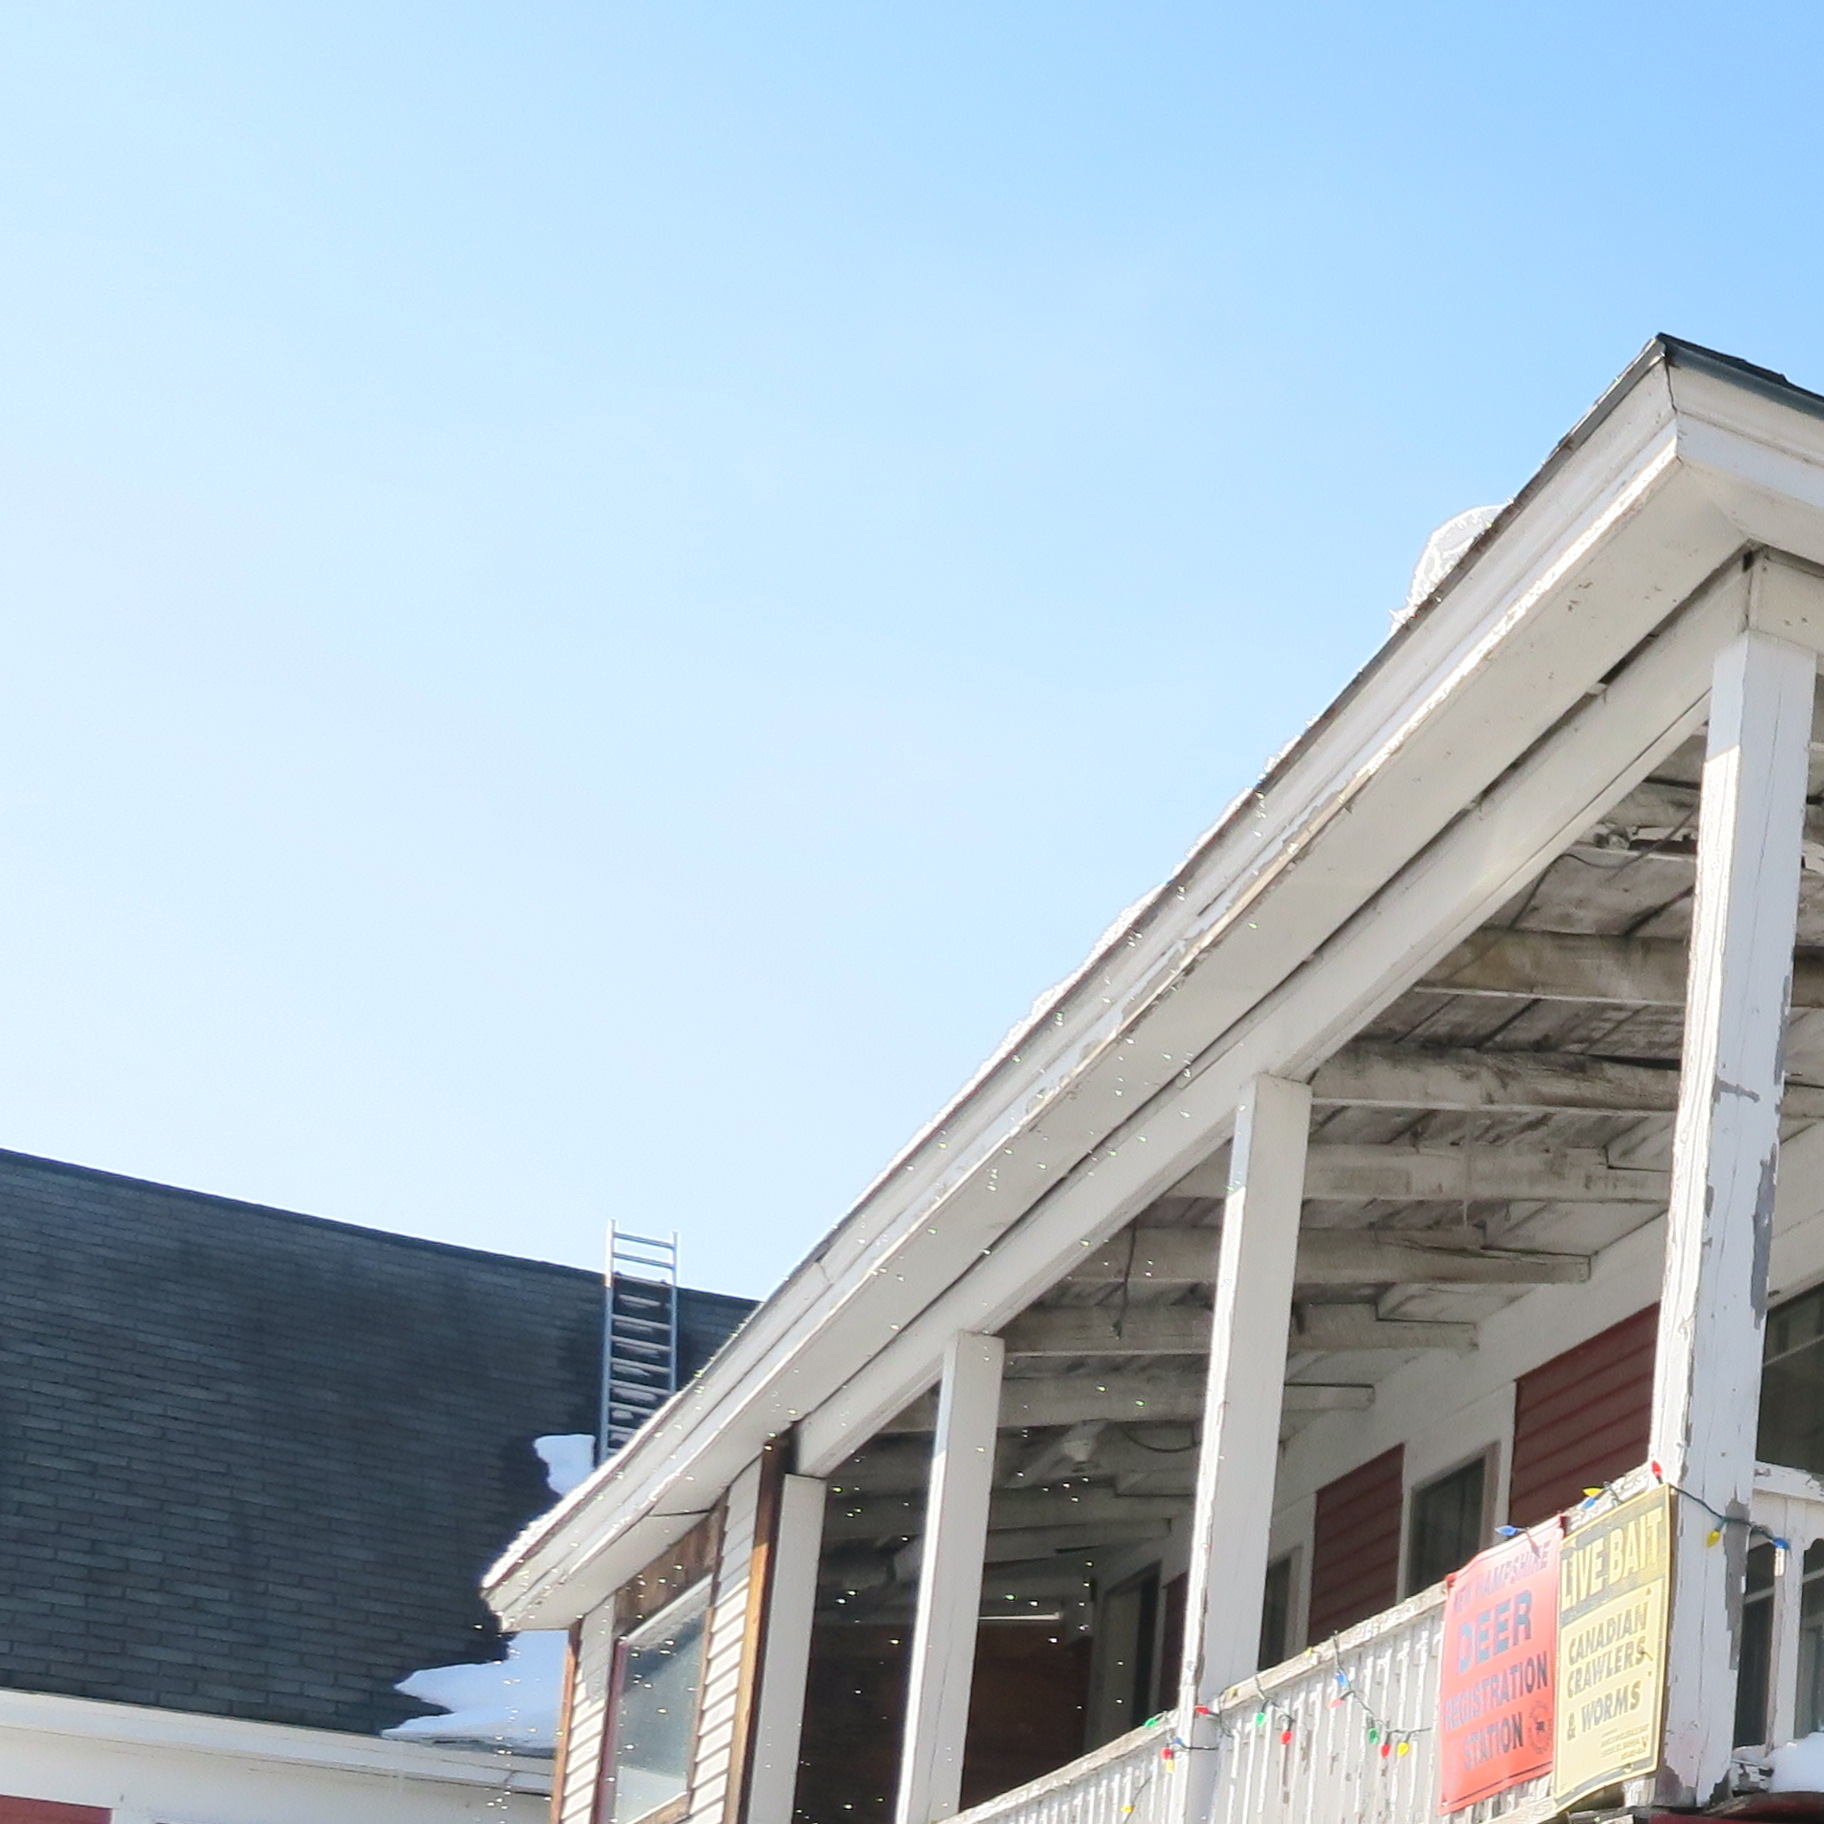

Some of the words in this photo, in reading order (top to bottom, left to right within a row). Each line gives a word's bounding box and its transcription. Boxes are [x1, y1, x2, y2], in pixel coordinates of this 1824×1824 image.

[1561, 1537, 1607, 1612] LIVE
[1607, 1506, 1663, 1585] BAIT
[1457, 1590, 1533, 1676] DEER
[1568, 1601, 1649, 1667] CANADIAN
[1444, 1650, 1548, 1733] REGISTRATION
[1566, 1635, 1646, 1699] CRAWLERS
[1463, 1710, 1524, 1771] STATION
[1566, 1711, 1576, 1742] &
[1580, 1680, 1642, 1733] WORMS
